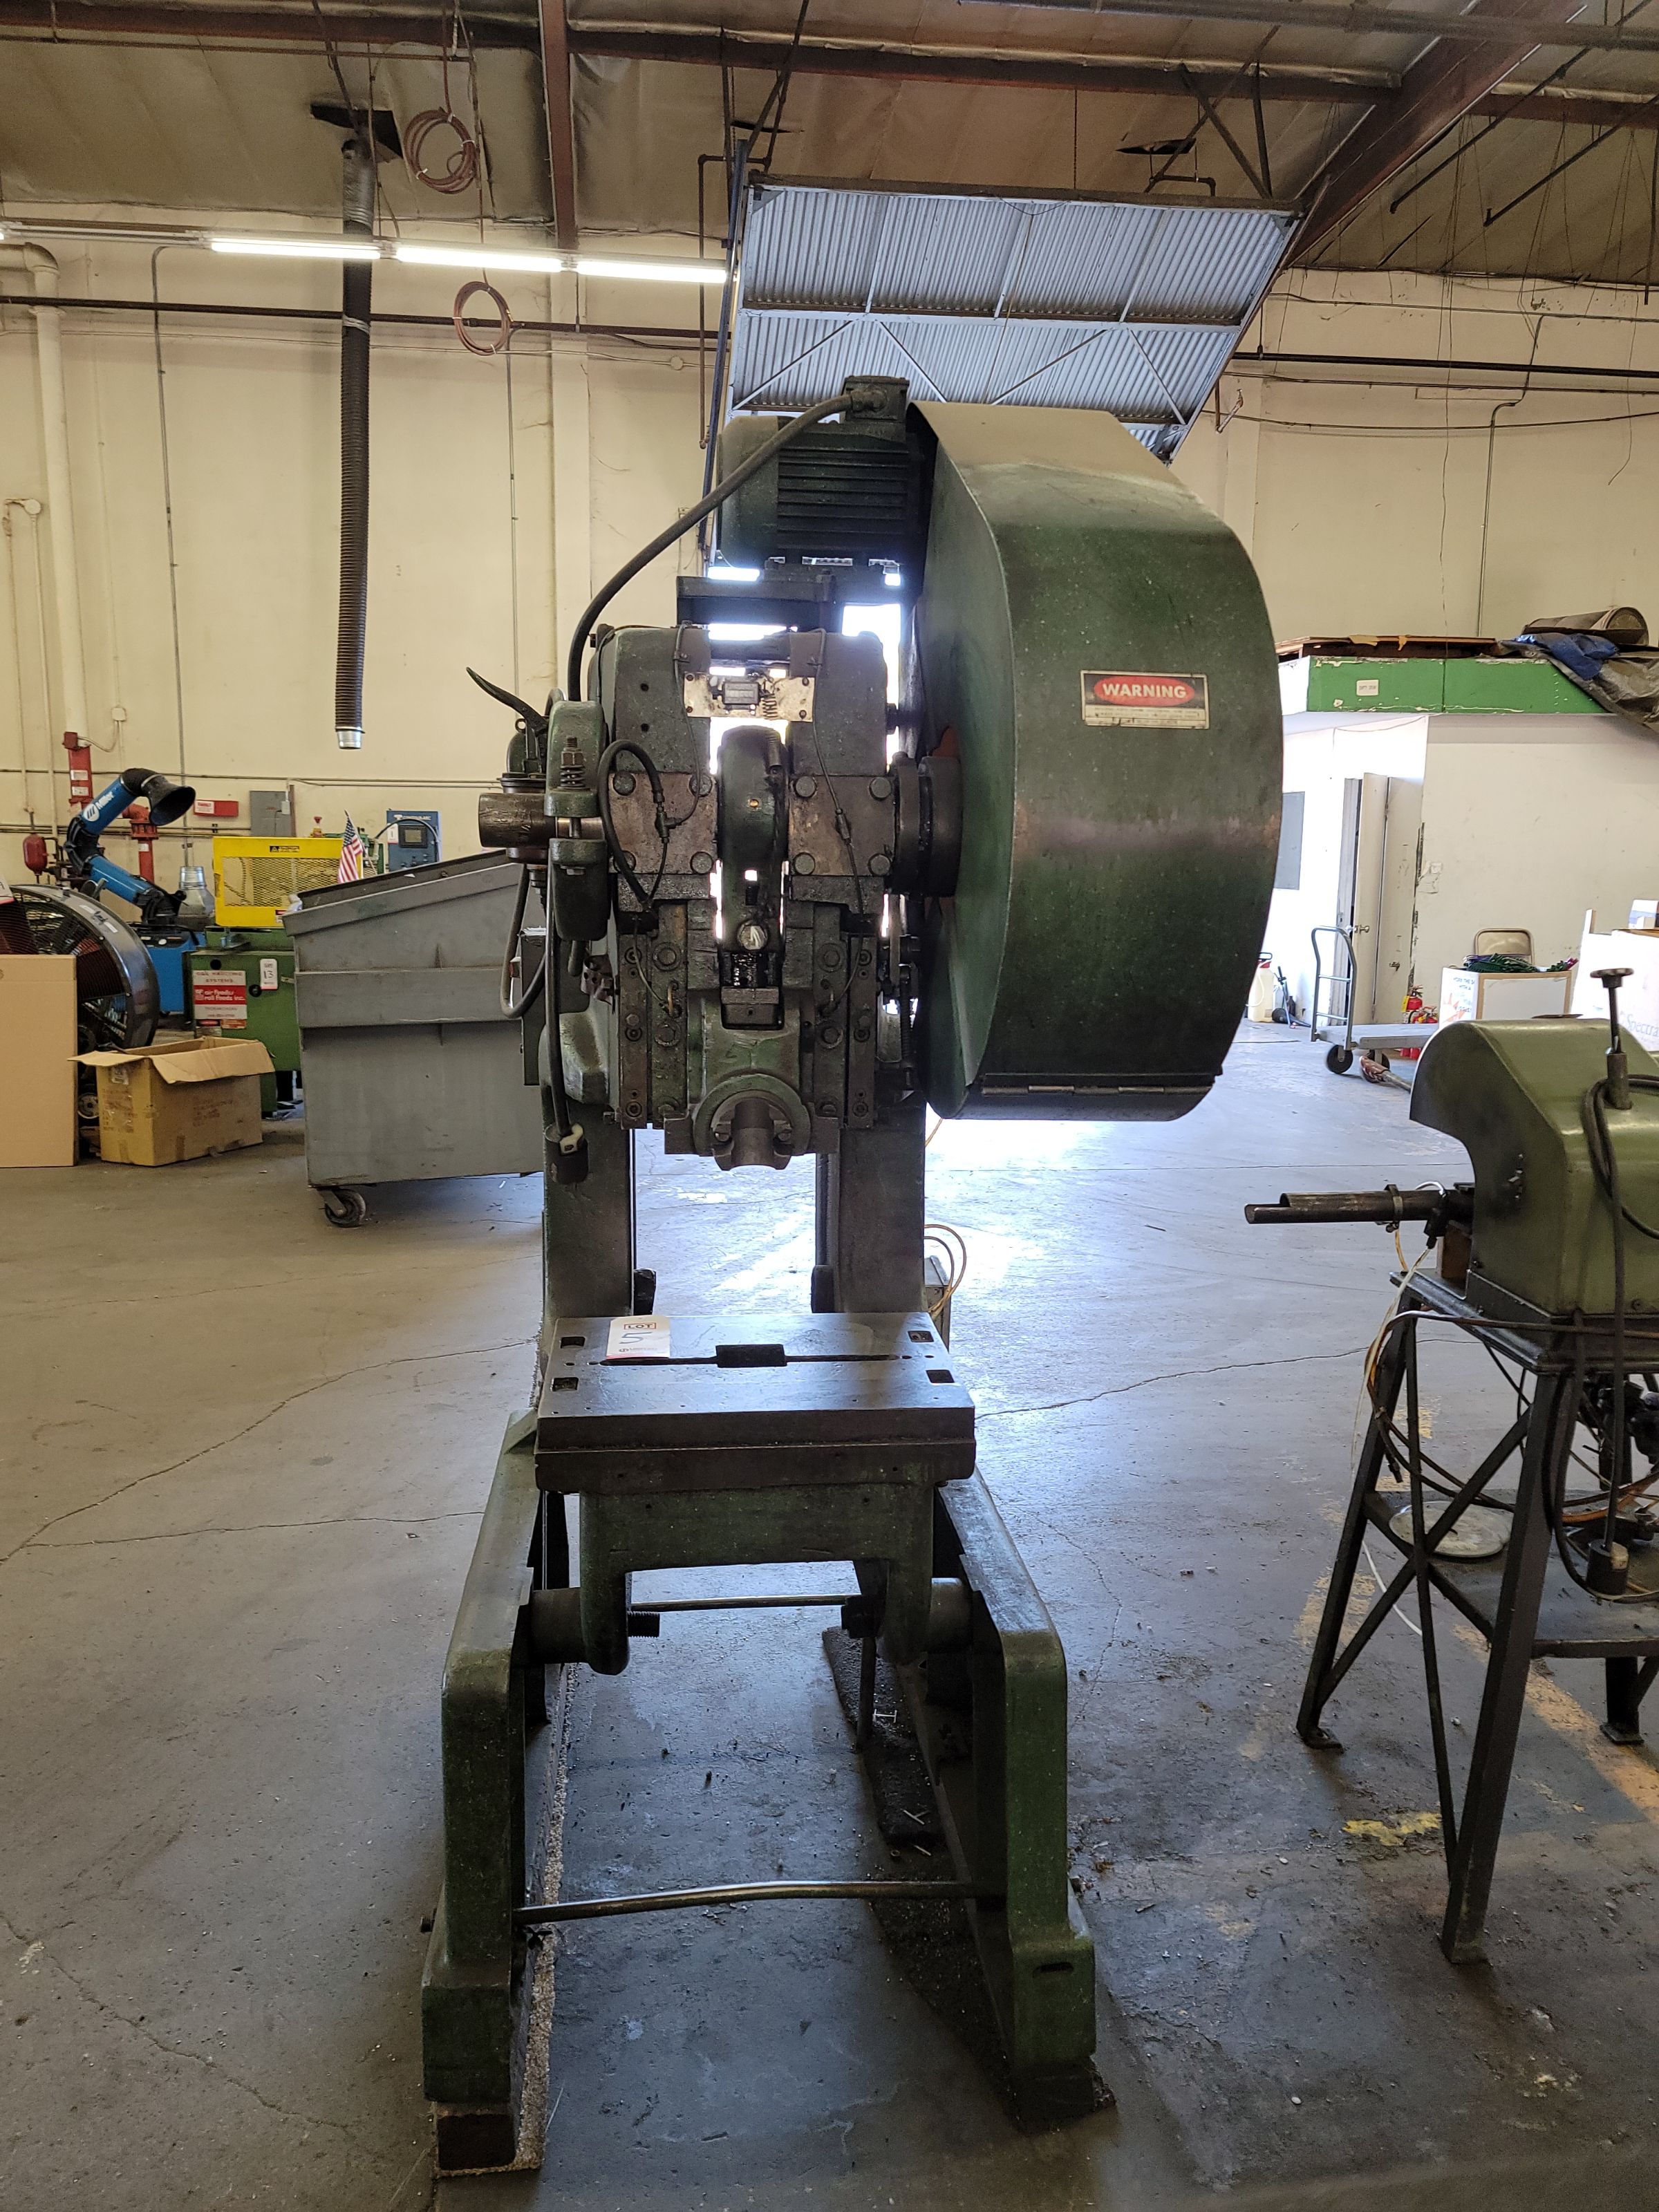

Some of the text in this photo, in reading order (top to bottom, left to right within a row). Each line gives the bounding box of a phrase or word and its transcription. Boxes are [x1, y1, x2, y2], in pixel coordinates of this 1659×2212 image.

[1103, 683, 1187, 698] WARNING
[95, 791, 115, 810] Miller
[619, 1331, 653, 1344] 5
